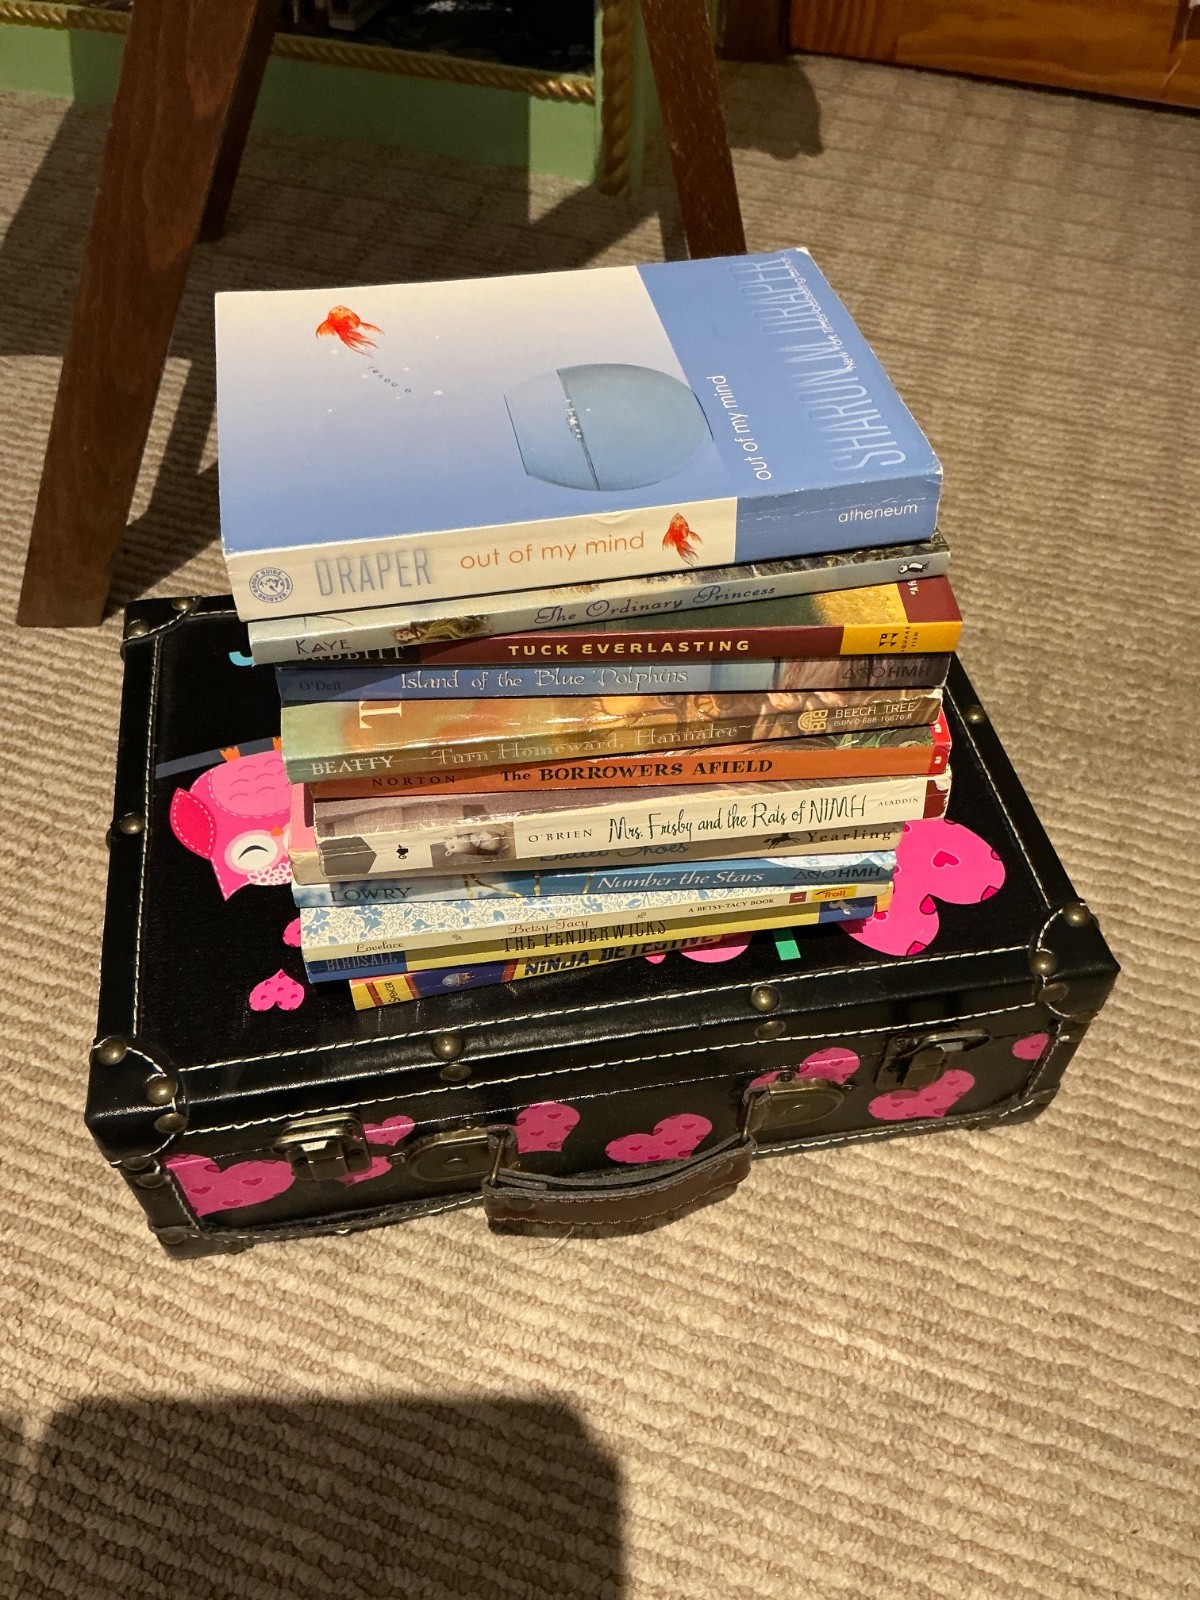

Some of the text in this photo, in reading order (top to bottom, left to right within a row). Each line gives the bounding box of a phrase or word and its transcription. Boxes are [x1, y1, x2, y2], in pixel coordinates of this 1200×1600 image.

[729, 256, 824, 335] DRAPER
[826, 334, 845, 350] York
[838, 351, 857, 369] New
[706, 375, 772, 481] out of my mind
[790, 367, 907, 472] SHARON
[838, 502, 918, 523] atheneum
[460, 531, 644, 569] out of my mind
[314, 548, 433, 597] DRAPER
[534, 585, 776, 625] The Ordinary Princess
[295, 638, 351, 656] KAYE
[508, 640, 750, 656] TUCK EVERLASTING
[300, 681, 341, 691] O'Dell
[402, 668, 689, 692] Island of the Blue Dolphins
[835, 702, 916, 719] BEECH TREE
[833, 718, 854, 727] ISBN
[311, 755, 394, 776] BEATTY
[432, 748, 489, 765] Turn
[501, 759, 773, 782] The BORROWERS AFIELD
[372, 775, 457, 787] NORTON
[878, 797, 919, 807] ALADDIN
[528, 795, 867, 843] O'BRIEN Mrs. Frisby and the Rats of NIMH
[806, 829, 892, 843] Yearling
[597, 870, 766, 889] Number the Stars
[330, 886, 411, 902] LOWRY
[697, 901, 748, 912] BETSY-TACY
[750, 898, 775, 906] BOOK
[507, 918, 589, 934] Betsy-Tacy
[501, 919, 666, 953] THE PENDERWICKS
[355, 941, 405, 953] Lovelace
[326, 952, 398, 971] BIRDSALL
